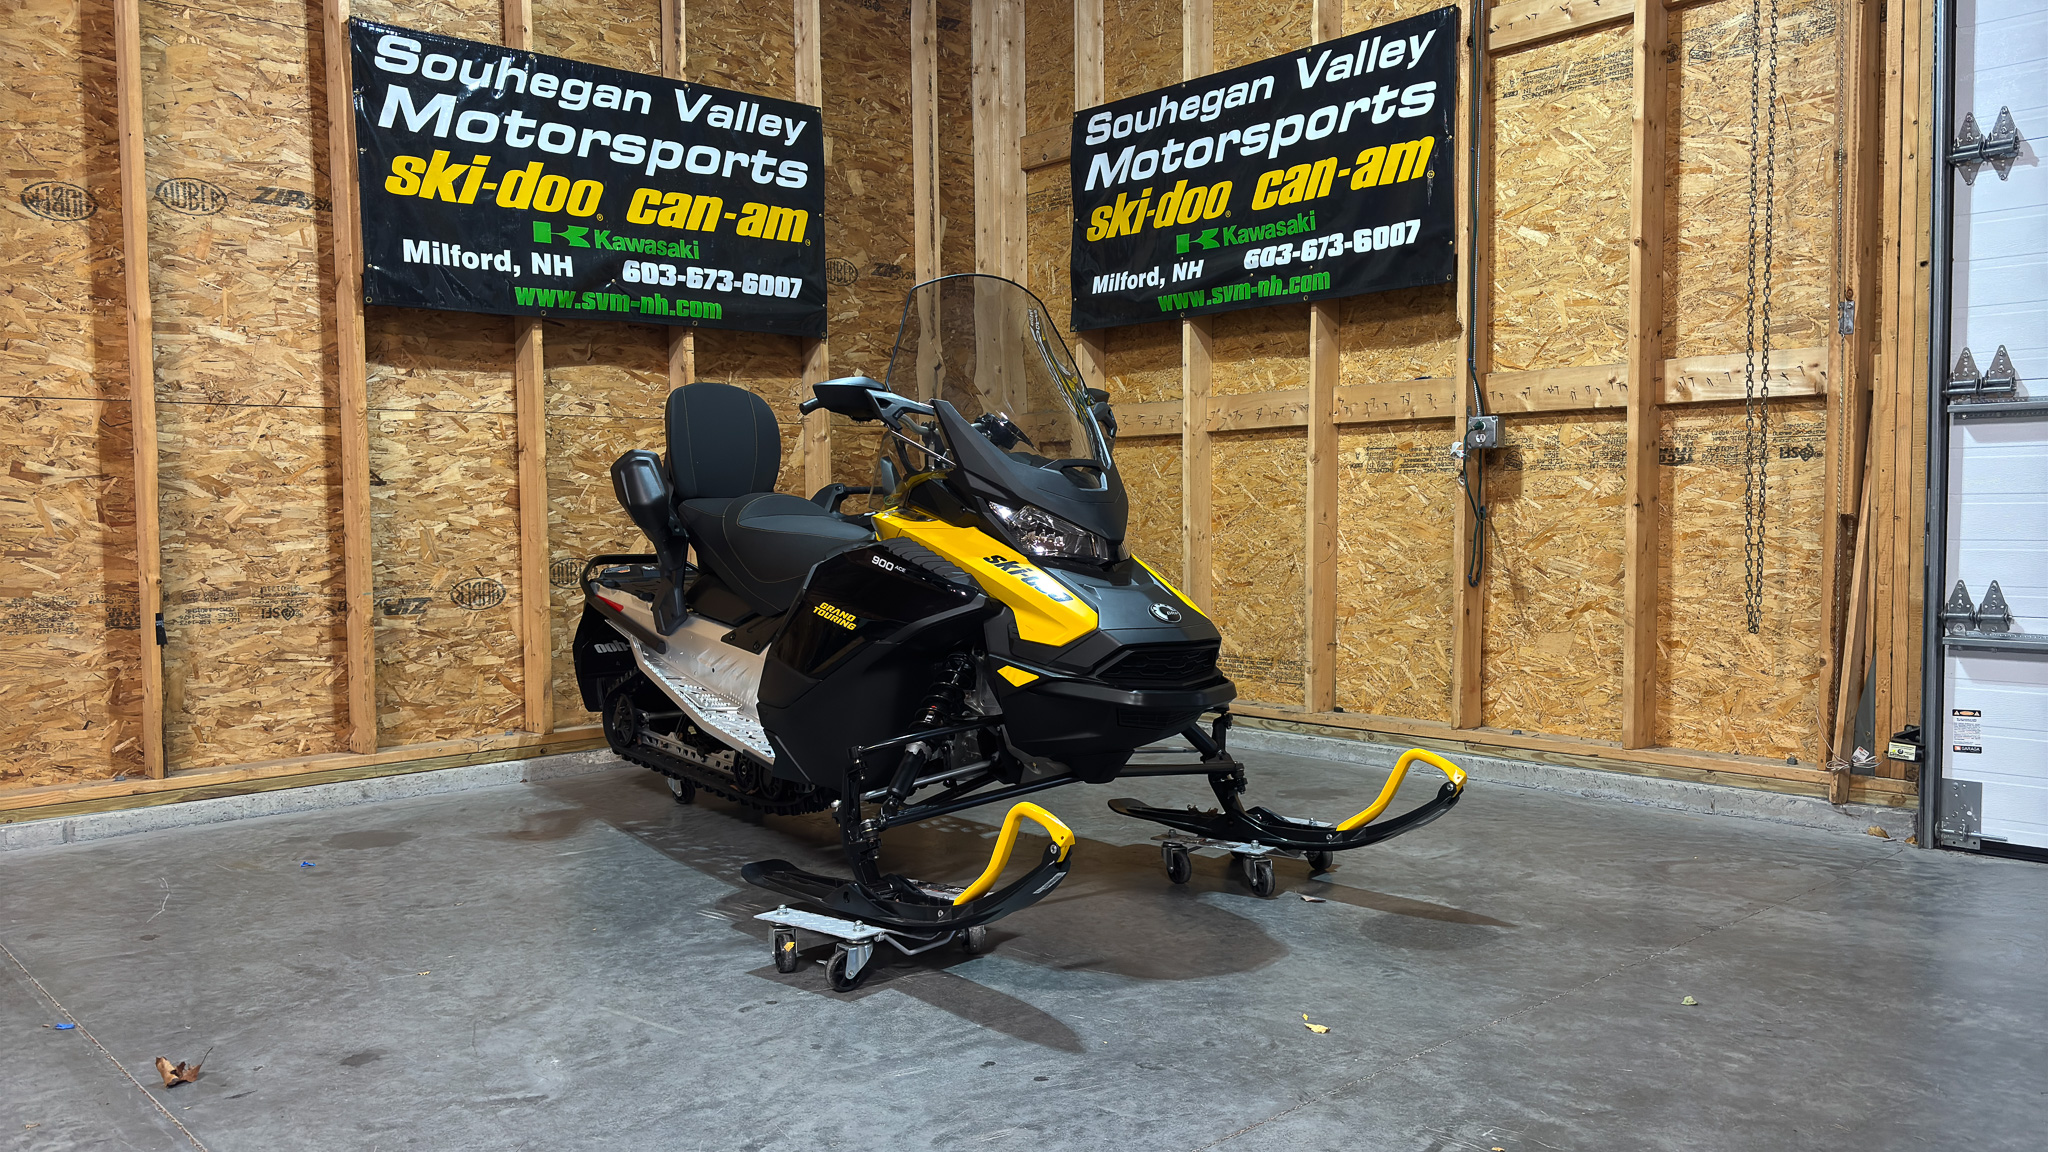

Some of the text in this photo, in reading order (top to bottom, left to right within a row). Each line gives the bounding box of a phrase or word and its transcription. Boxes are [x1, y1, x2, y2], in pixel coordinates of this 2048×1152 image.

[375, 32, 808, 147] Souhegan Valley
[1085, 28, 1437, 146] Souhegan Valley
[377, 84, 809, 189] Motorsports
[1084, 80, 1437, 192] Motorsports
[161, 180, 224, 213] HUBER
[384, 149, 809, 243] ski-doo can-am
[1086, 180, 1233, 242] ski-doo
[1251, 136, 1435, 211] can-am
[594, 229, 699, 260] Kawasaki
[1223, 210, 1317, 246] Kawasaki
[1243, 219, 1422, 270] 603-673-6007
[402, 239, 574, 278] Milford, NH
[1091, 260, 1205, 295] Milford, NH
[622, 260, 803, 299] 603-673-6007
[1157, 270, 1331, 311] www.svm-nh.com
[514, 285, 723, 320] www.svm-nh.com
[871, 555, 906, 573] 900 ACE
[983, 555, 1074, 602] ski-d
[812, 606, 857, 631] TOURING
[819, 602, 857, 622] GRAND
